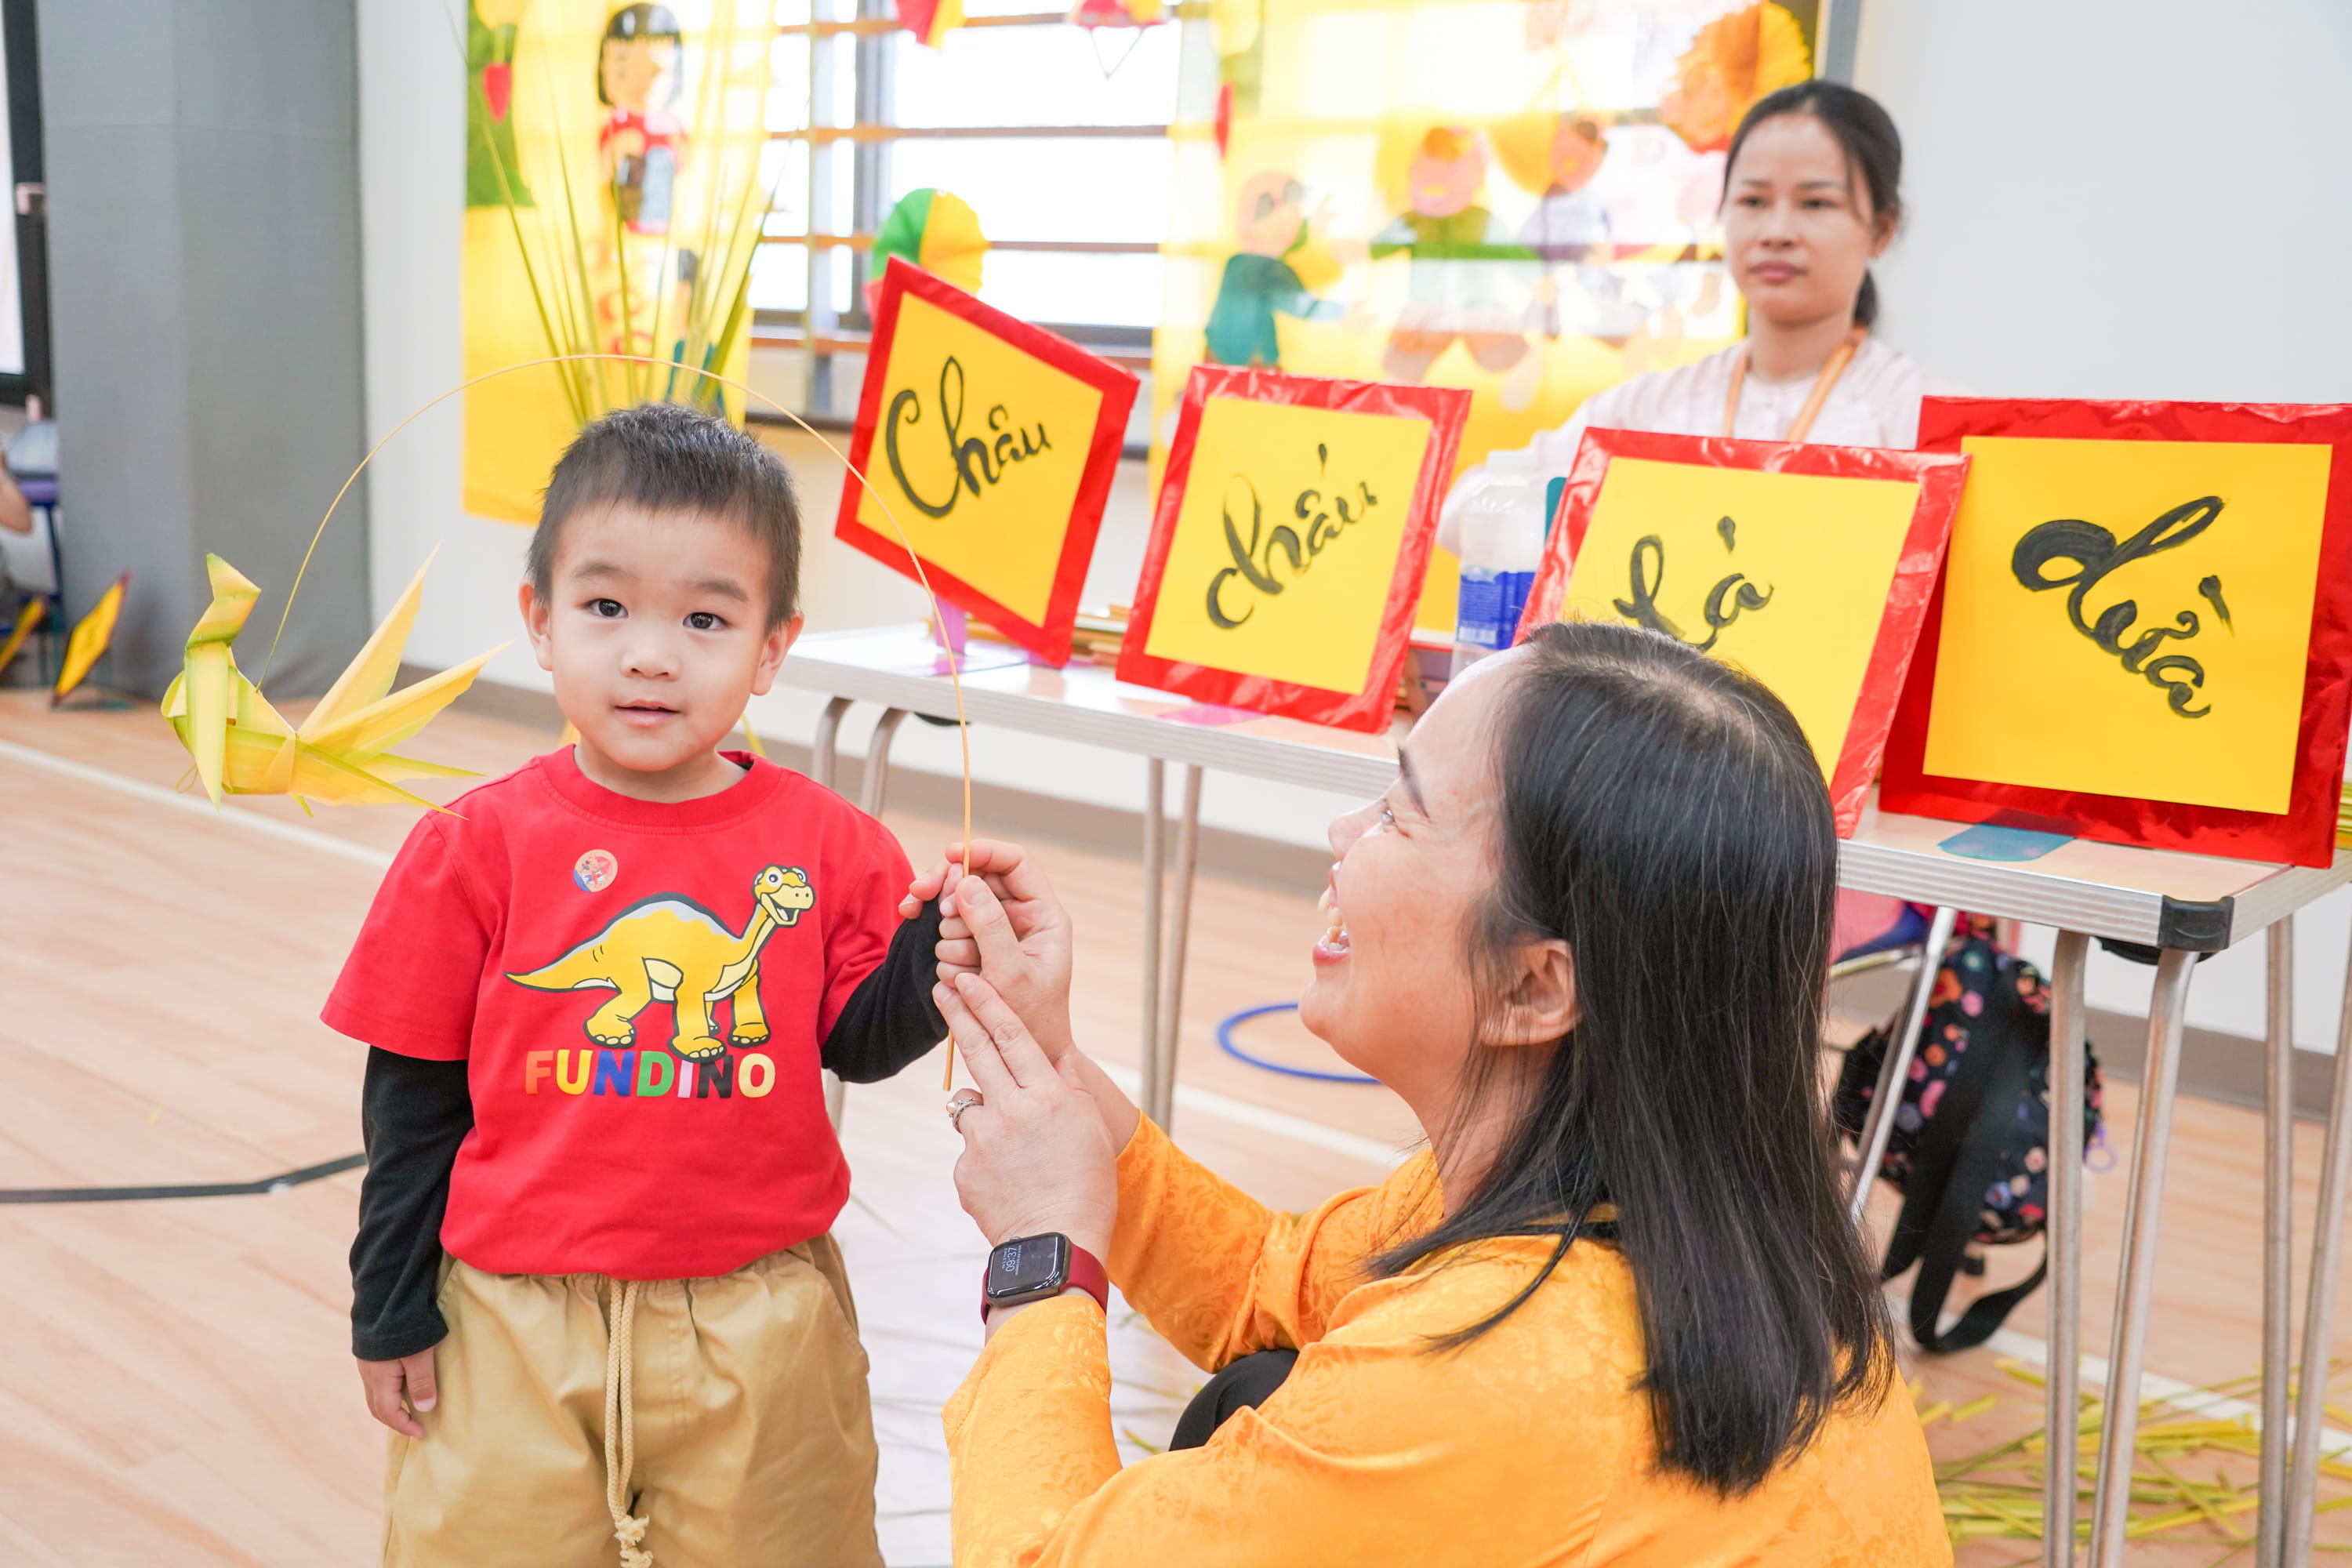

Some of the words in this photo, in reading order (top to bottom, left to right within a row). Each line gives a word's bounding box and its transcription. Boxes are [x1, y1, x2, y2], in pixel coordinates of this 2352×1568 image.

[885, 355, 1053, 520] Châu
[524, 1049, 776, 1098] FUNDINO
[1005, 1247, 1018, 1272] 09:37
